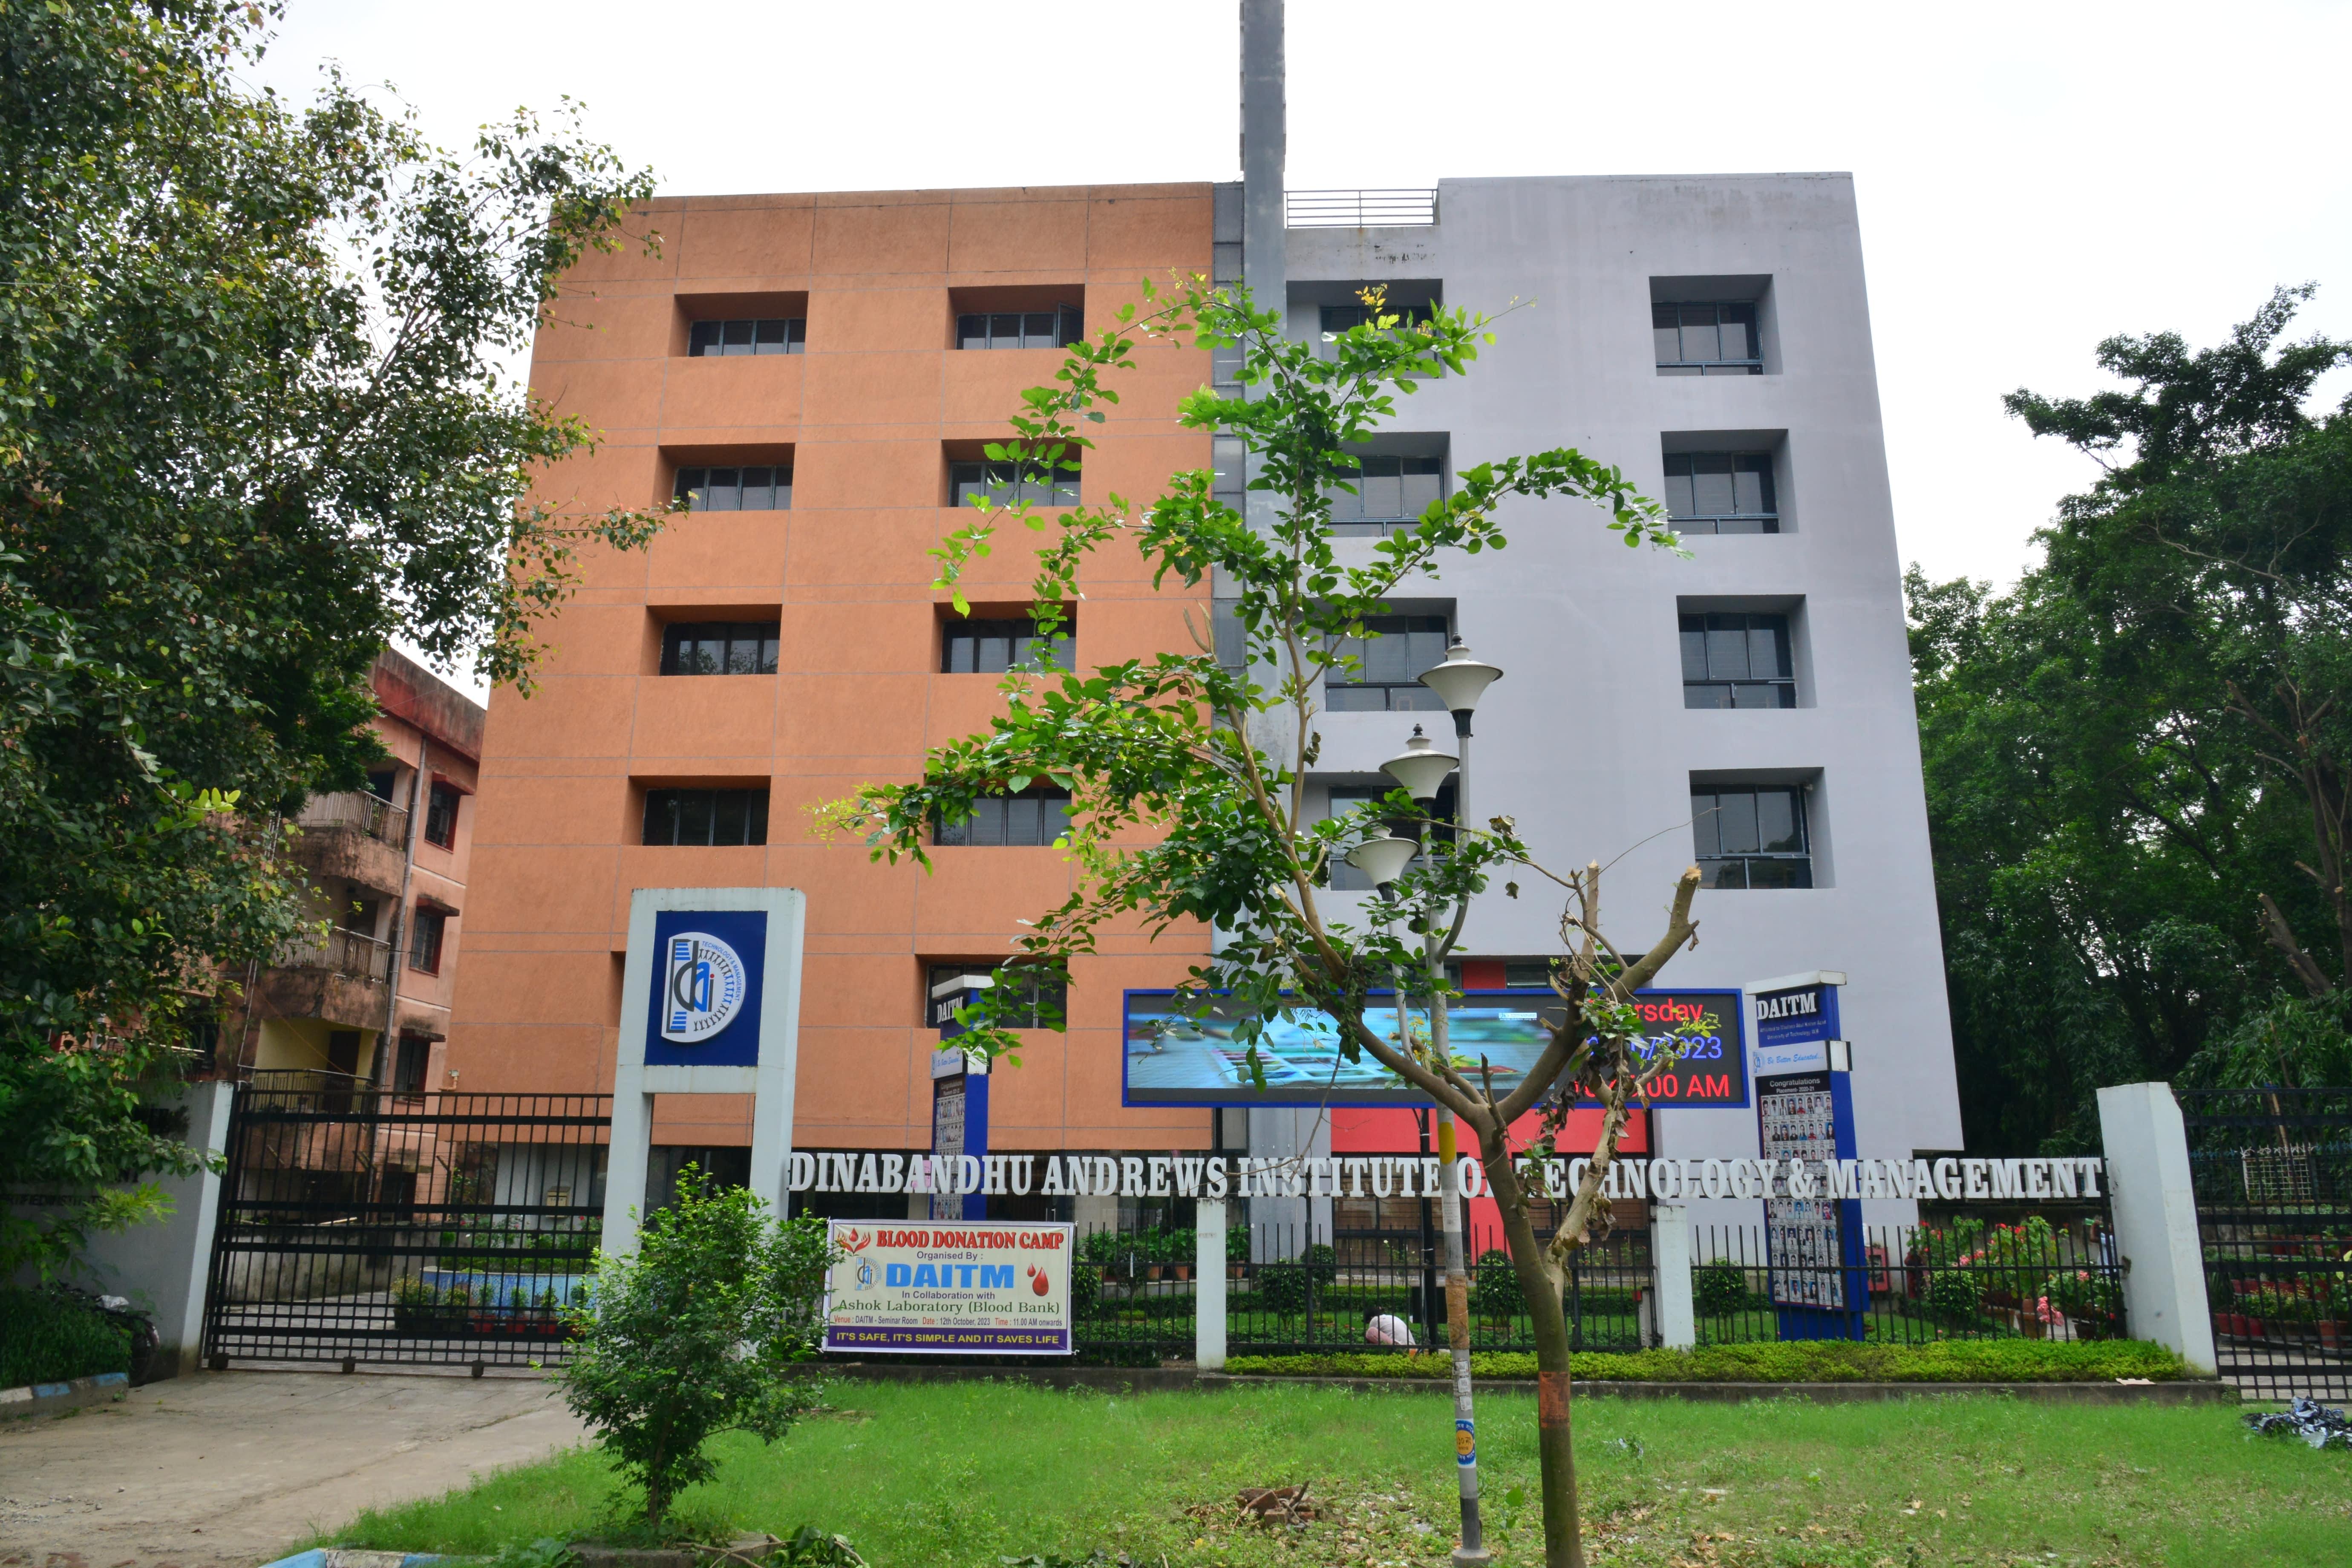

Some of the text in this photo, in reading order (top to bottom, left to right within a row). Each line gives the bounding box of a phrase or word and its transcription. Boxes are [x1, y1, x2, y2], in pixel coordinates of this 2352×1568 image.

[702, 941, 733, 960] TECHNOLOGY
[733, 964, 742, 1001] MANAGEMENT
[1757, 992, 1816, 1020] DAITM
[1776, 1056, 1791, 1064] Better
[1686, 1074, 1729, 1098] AM
[1770, 1078, 1820, 1088] Congratulations
[789, 1152, 1034, 1196] DINABANDHU
[1041, 1157, 1228, 1198] ANDREWS
[1237, 1157, 1441, 1198] INSTITUTE
[1788, 1157, 1816, 1199] &
[1827, 1157, 2102, 1199] MANAGEMENT
[876, 1230, 1064, 1249] BLOOD DONATION CAMP
[917, 1251, 963, 1261] Organised
[966, 1252, 977, 1261] By
[886, 1263, 1014, 1288] DAITM
[913, 1291, 973, 1299] Collaboration
[839, 1300, 1060, 1315] Ashok Laboratory (Blood Bank)
[834, 1315, 851, 1323] Venue
[855, 1316, 873, 1324] DAITM
[878, 1316, 901, 1324] Seminar
[902, 1317, 918, 1325] Room
[922, 1317, 935, 1325] Date
[953, 1318, 976, 1327] October,
[977, 1318, 991, 1326] 2023
[1028, 1318, 1038, 1326] AM
[837, 1332, 1059, 1344] IT'S SAFE, IT'S SIMPLE AND IT SAVES LIFE
